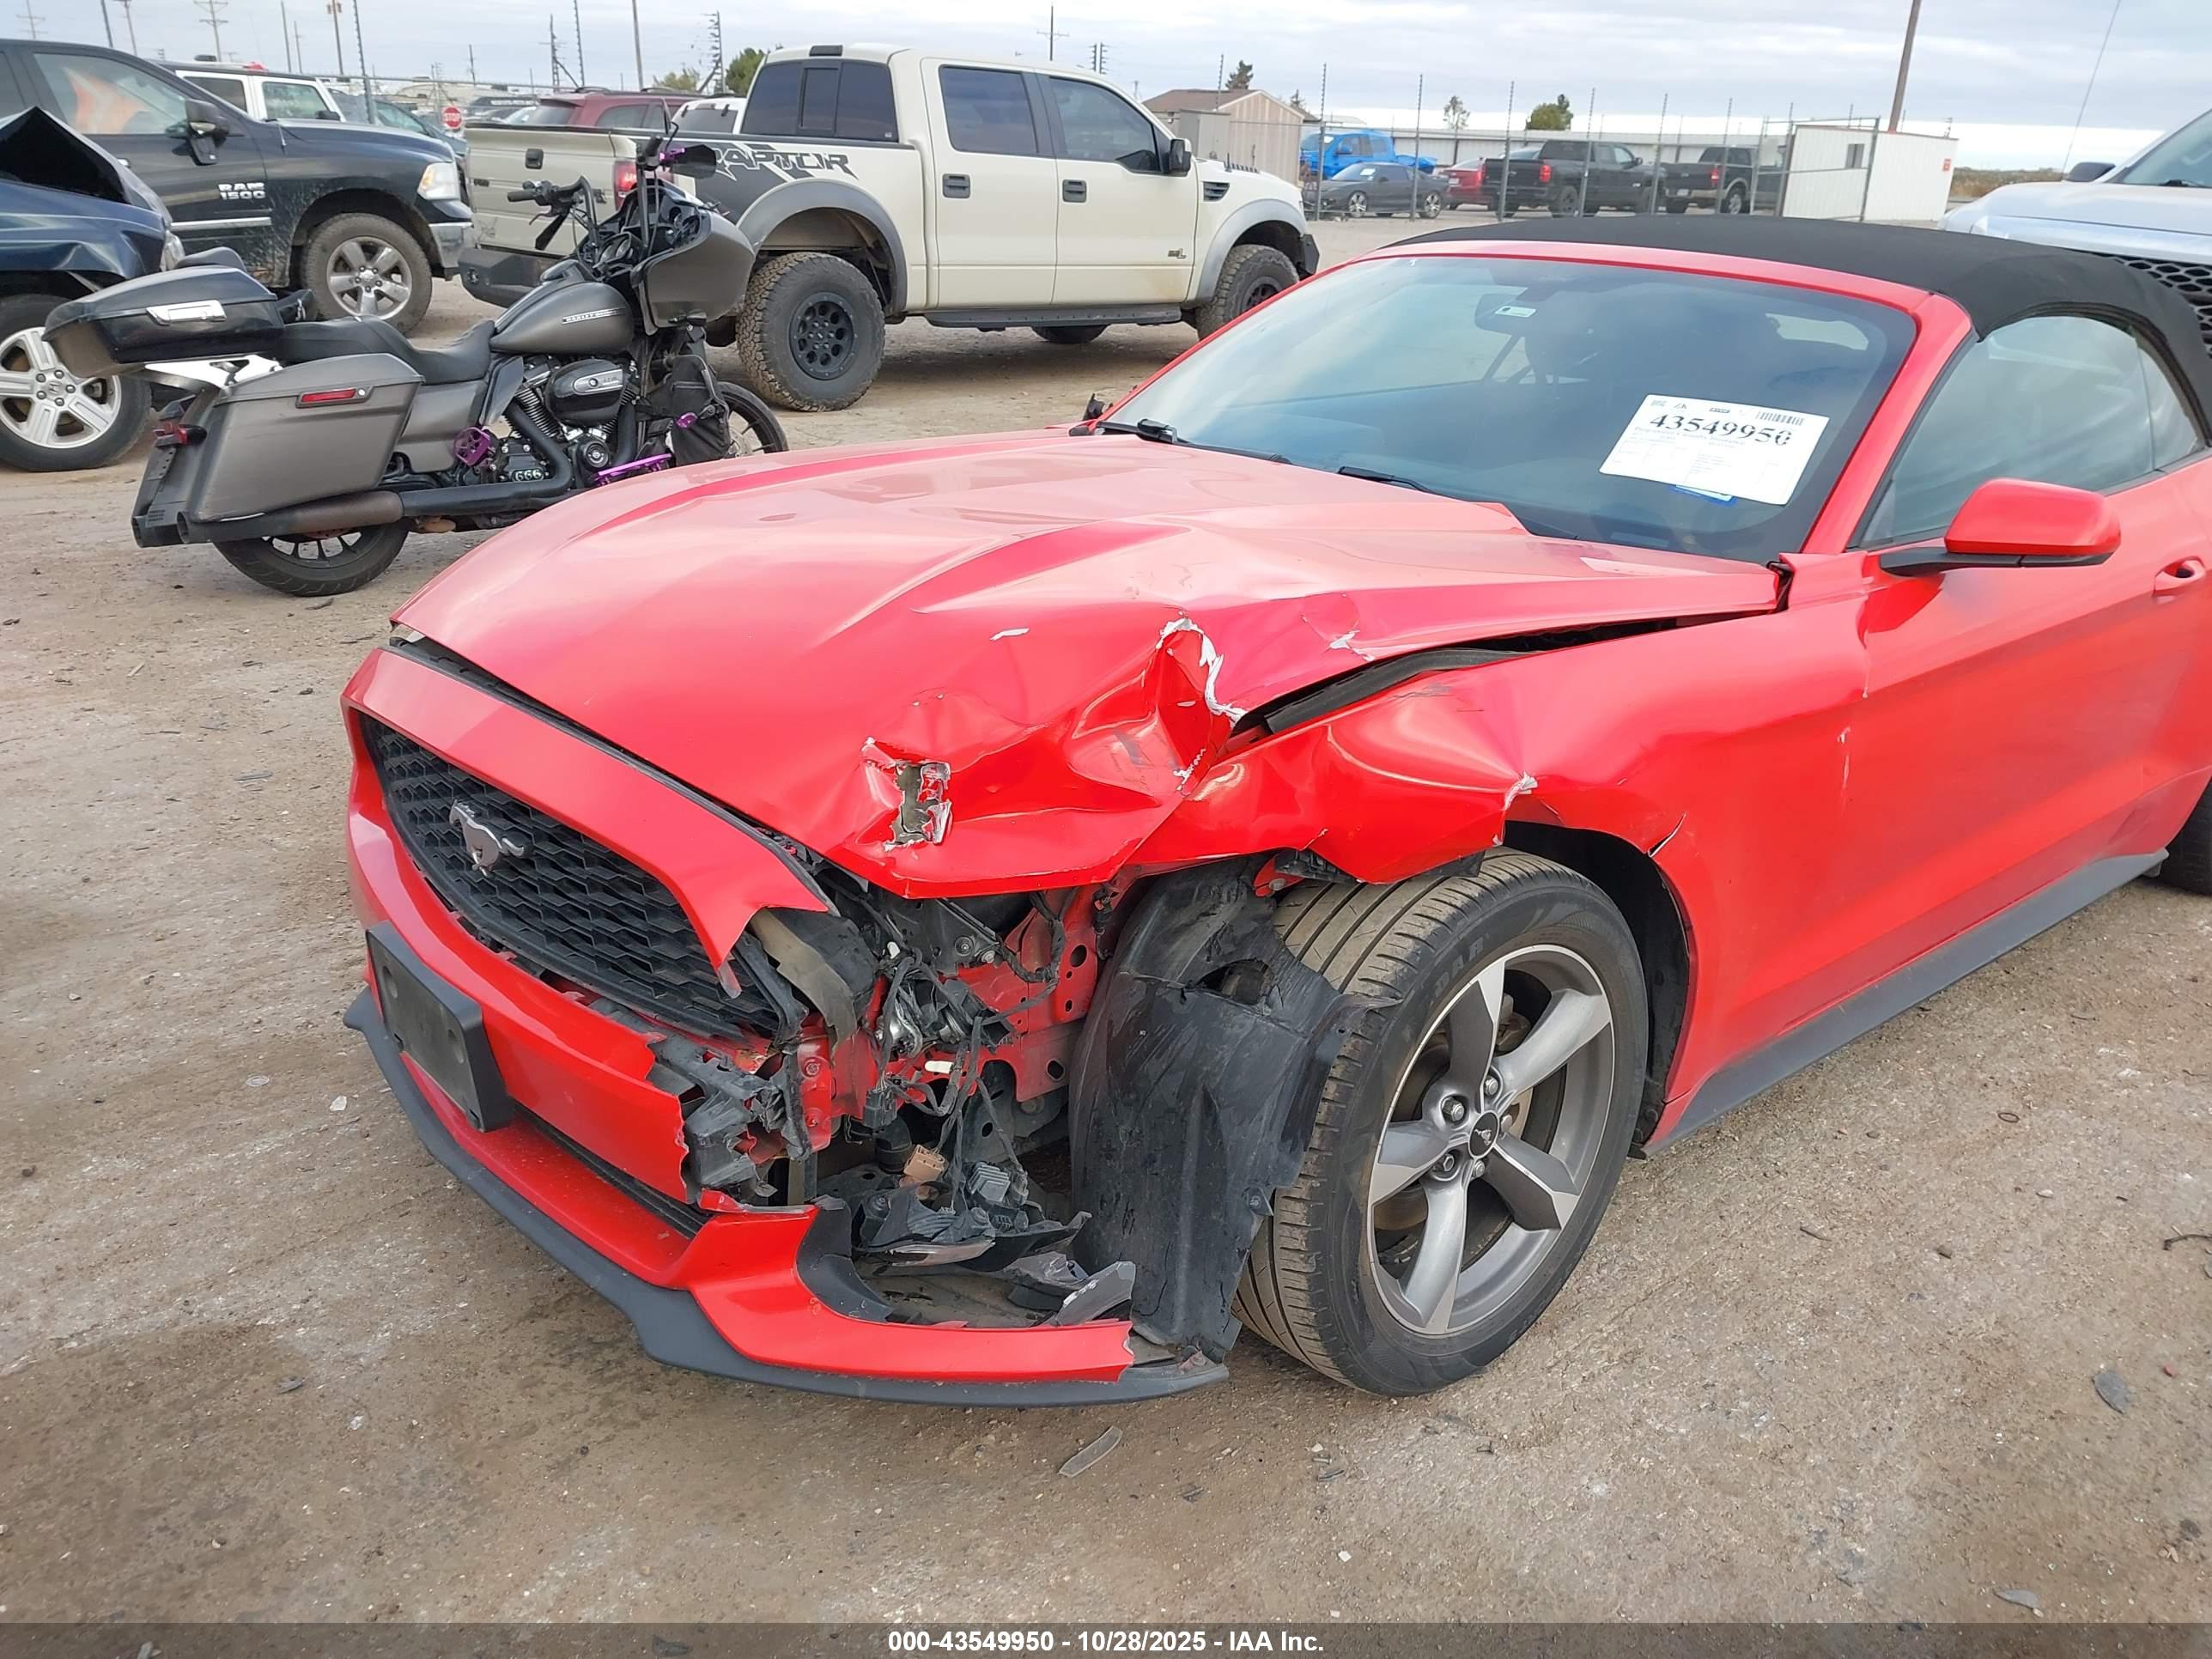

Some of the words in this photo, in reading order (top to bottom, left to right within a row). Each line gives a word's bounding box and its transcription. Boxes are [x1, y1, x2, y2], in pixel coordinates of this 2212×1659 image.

[443, 112, 461, 123] STOP
[218, 182, 264, 191] RAM
[220, 191, 266, 200] 1500
[1650, 414, 1792, 446] 43549950
[515, 470, 542, 482] 666
